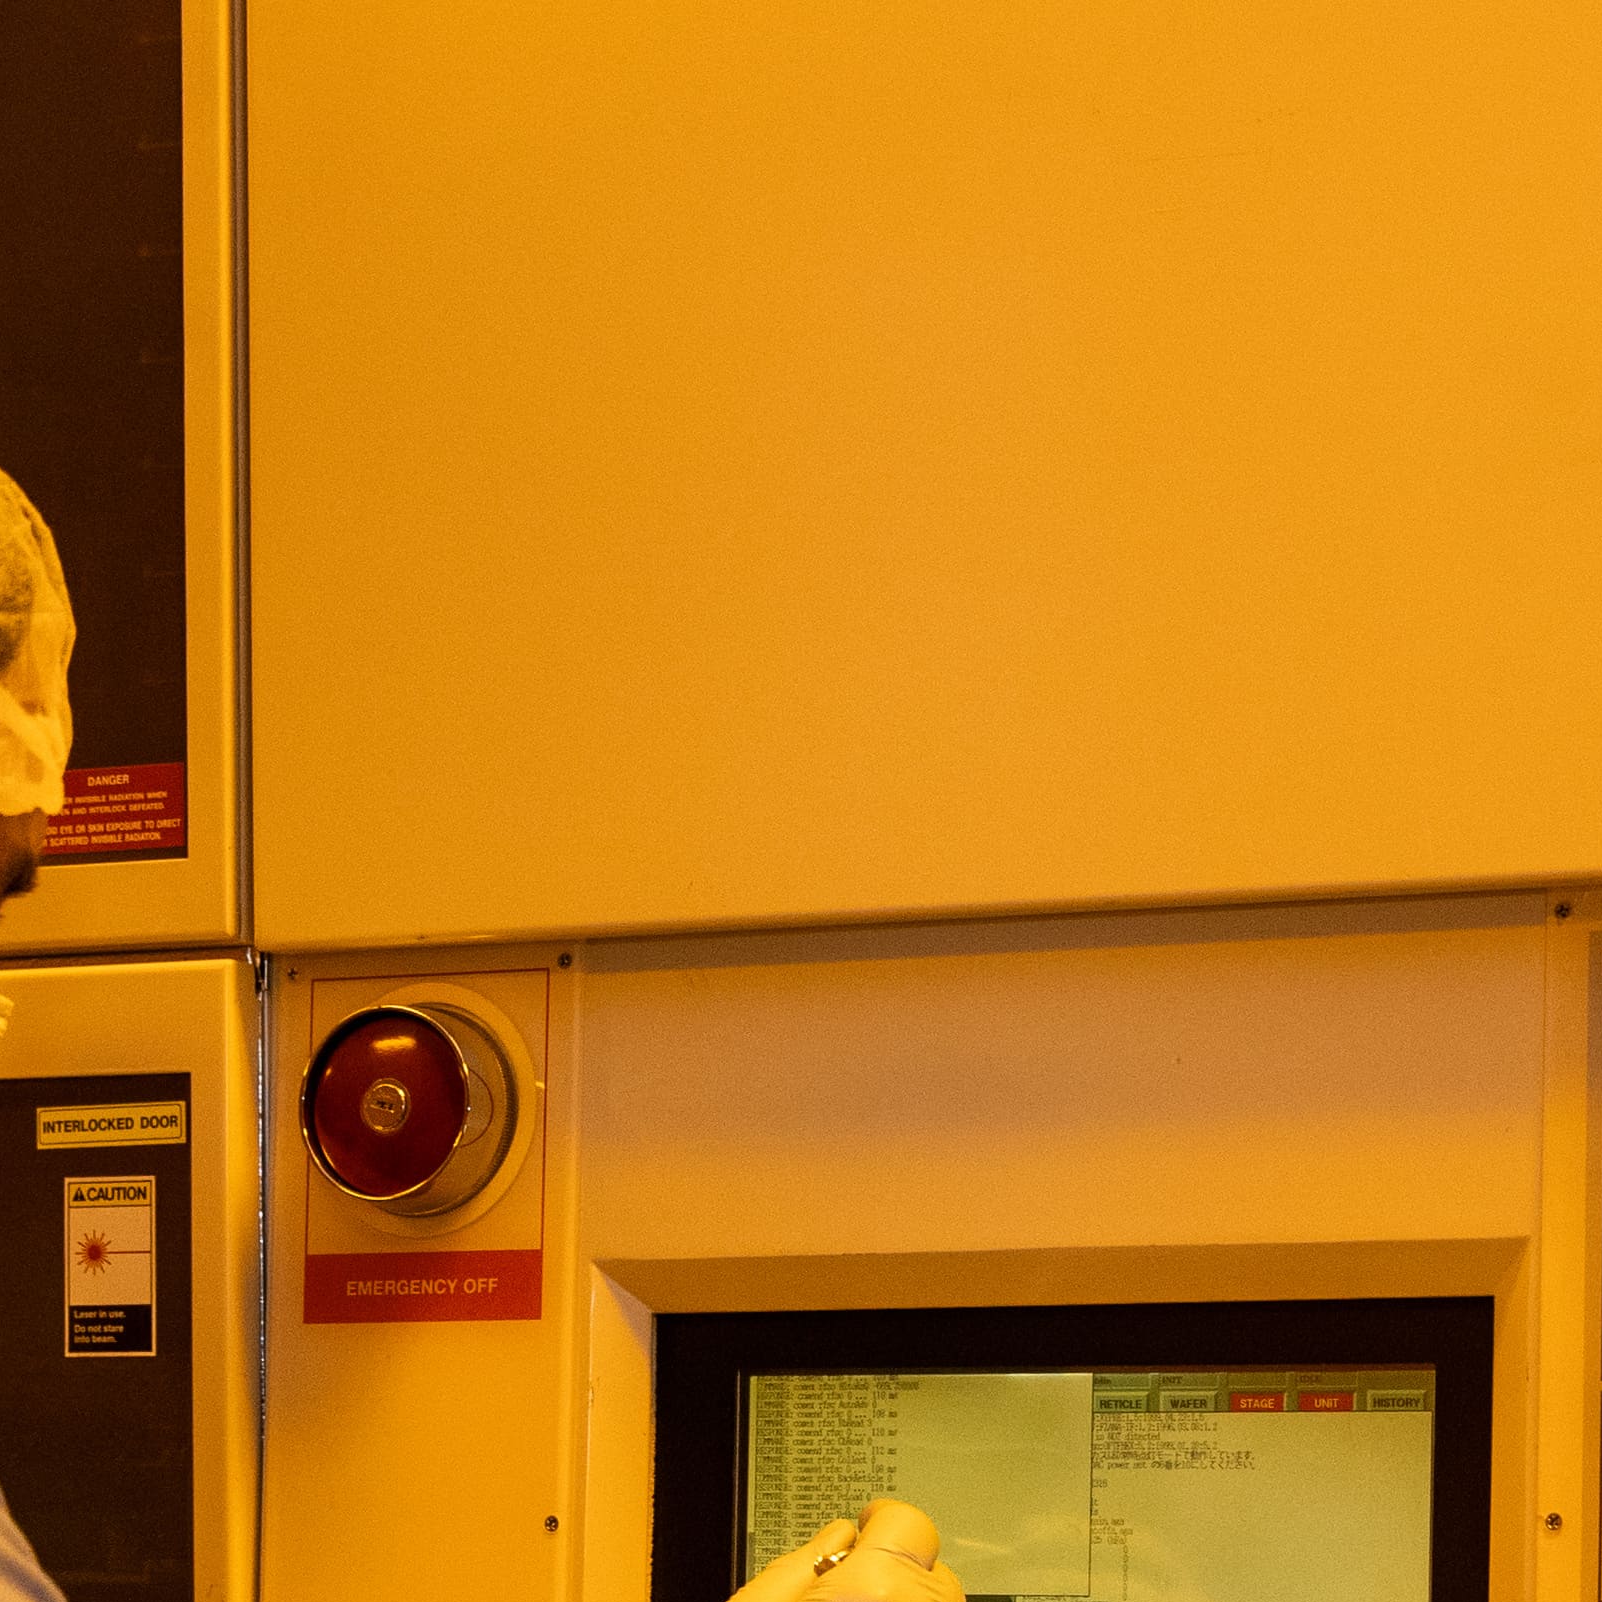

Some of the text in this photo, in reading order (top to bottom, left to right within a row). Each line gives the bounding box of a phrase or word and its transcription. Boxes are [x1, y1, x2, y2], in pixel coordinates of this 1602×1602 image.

[88, 774, 129, 786] DANGER
[43, 1115, 178, 1134] INTERLOCKED DOOR
[87, 1186, 147, 1201] CAUTION
[347, 1278, 498, 1296] EMERGENCY OFF
[74, 1310, 96, 1319] Laser
[99, 1310, 106, 1318] in
[74, 1325, 85, 1333] Do
[88, 1325, 101, 1333] not
[74, 1335, 117, 1343] into beam.
[1100, 1400, 1142, 1409] RETICLE
[1170, 1399, 1207, 1408] WAFER
[1240, 1399, 1274, 1408] STAGE
[1314, 1399, 1338, 1408] UNIT
[1373, 1398, 1420, 1407] HISTORY
